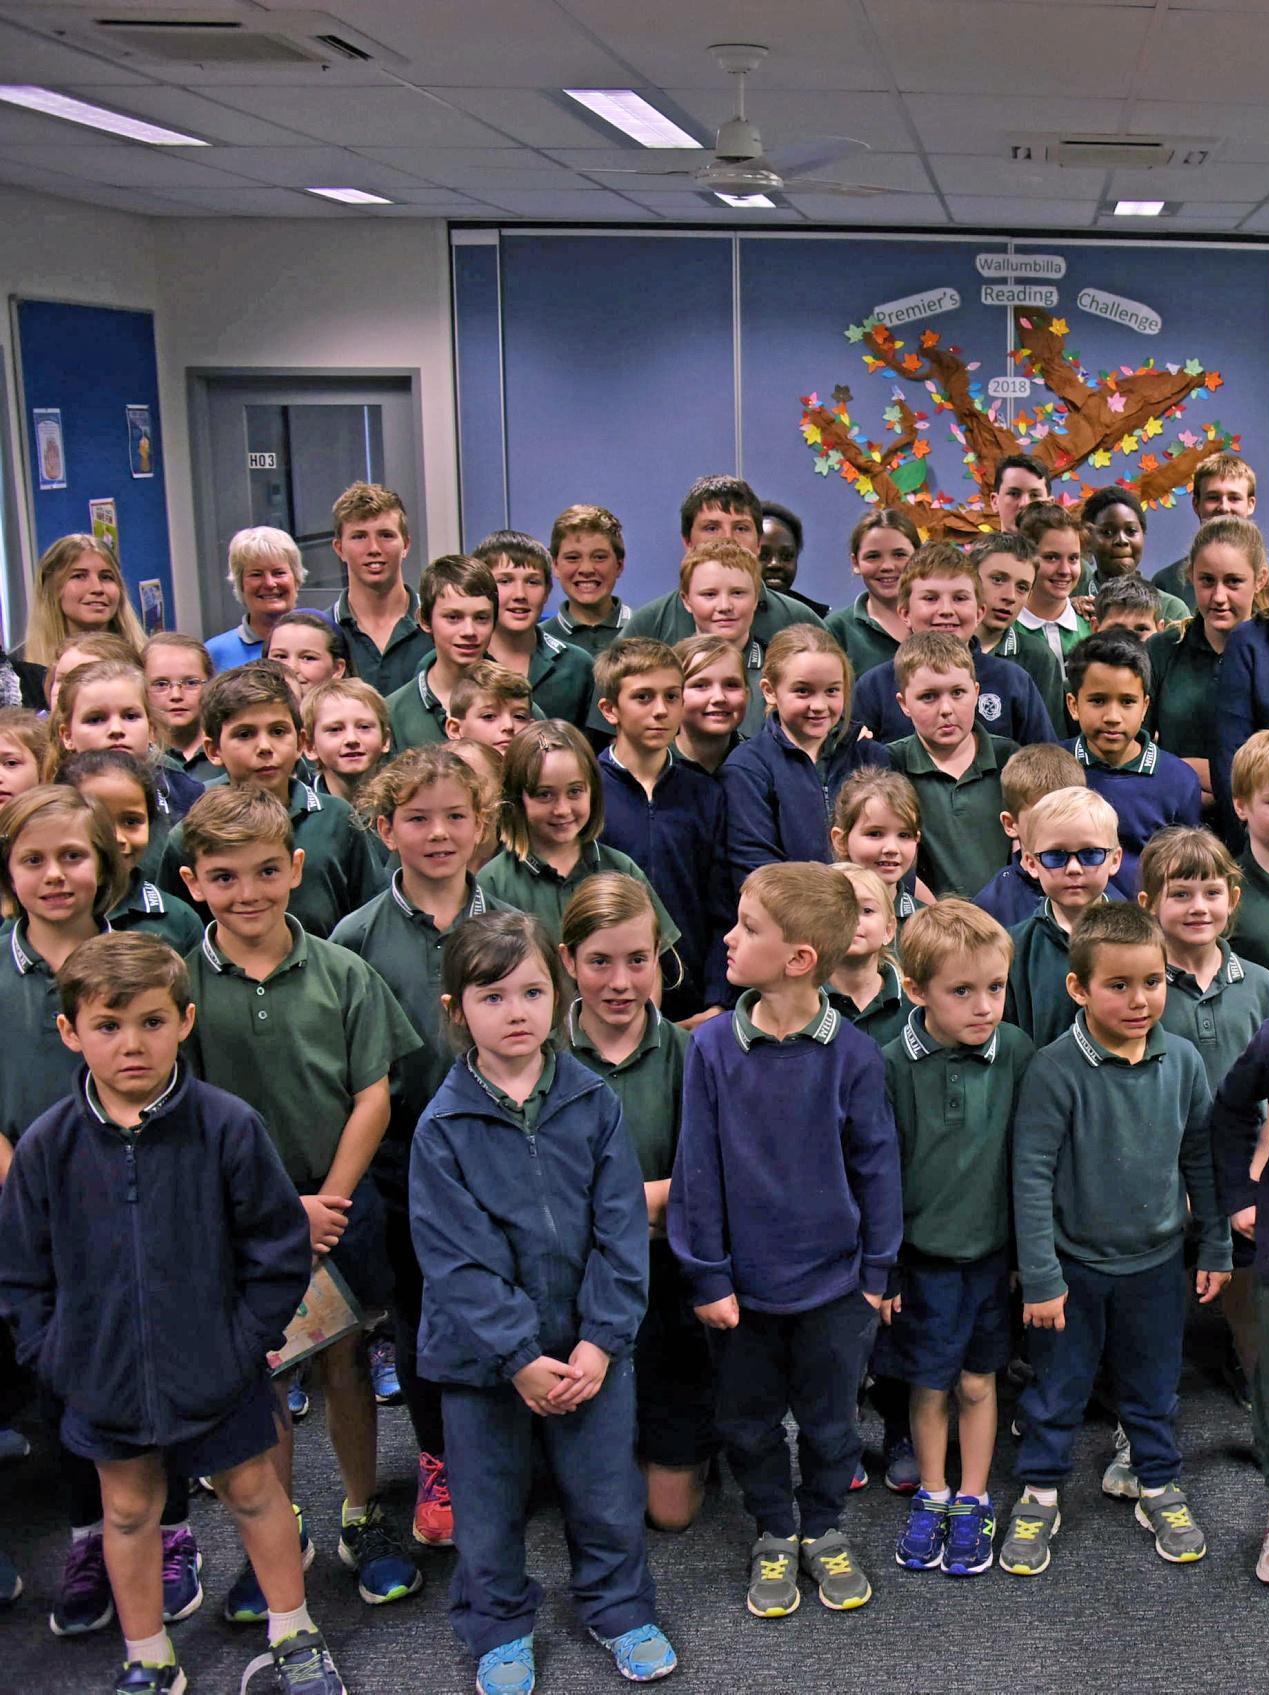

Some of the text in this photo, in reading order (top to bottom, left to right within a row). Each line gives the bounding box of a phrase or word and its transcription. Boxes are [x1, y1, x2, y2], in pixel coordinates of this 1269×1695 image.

[978, 258, 1062, 274] Wallumbilla
[876, 286, 1159, 332] Premier's Reading Challenge
[993, 380, 1027, 393] 2018
